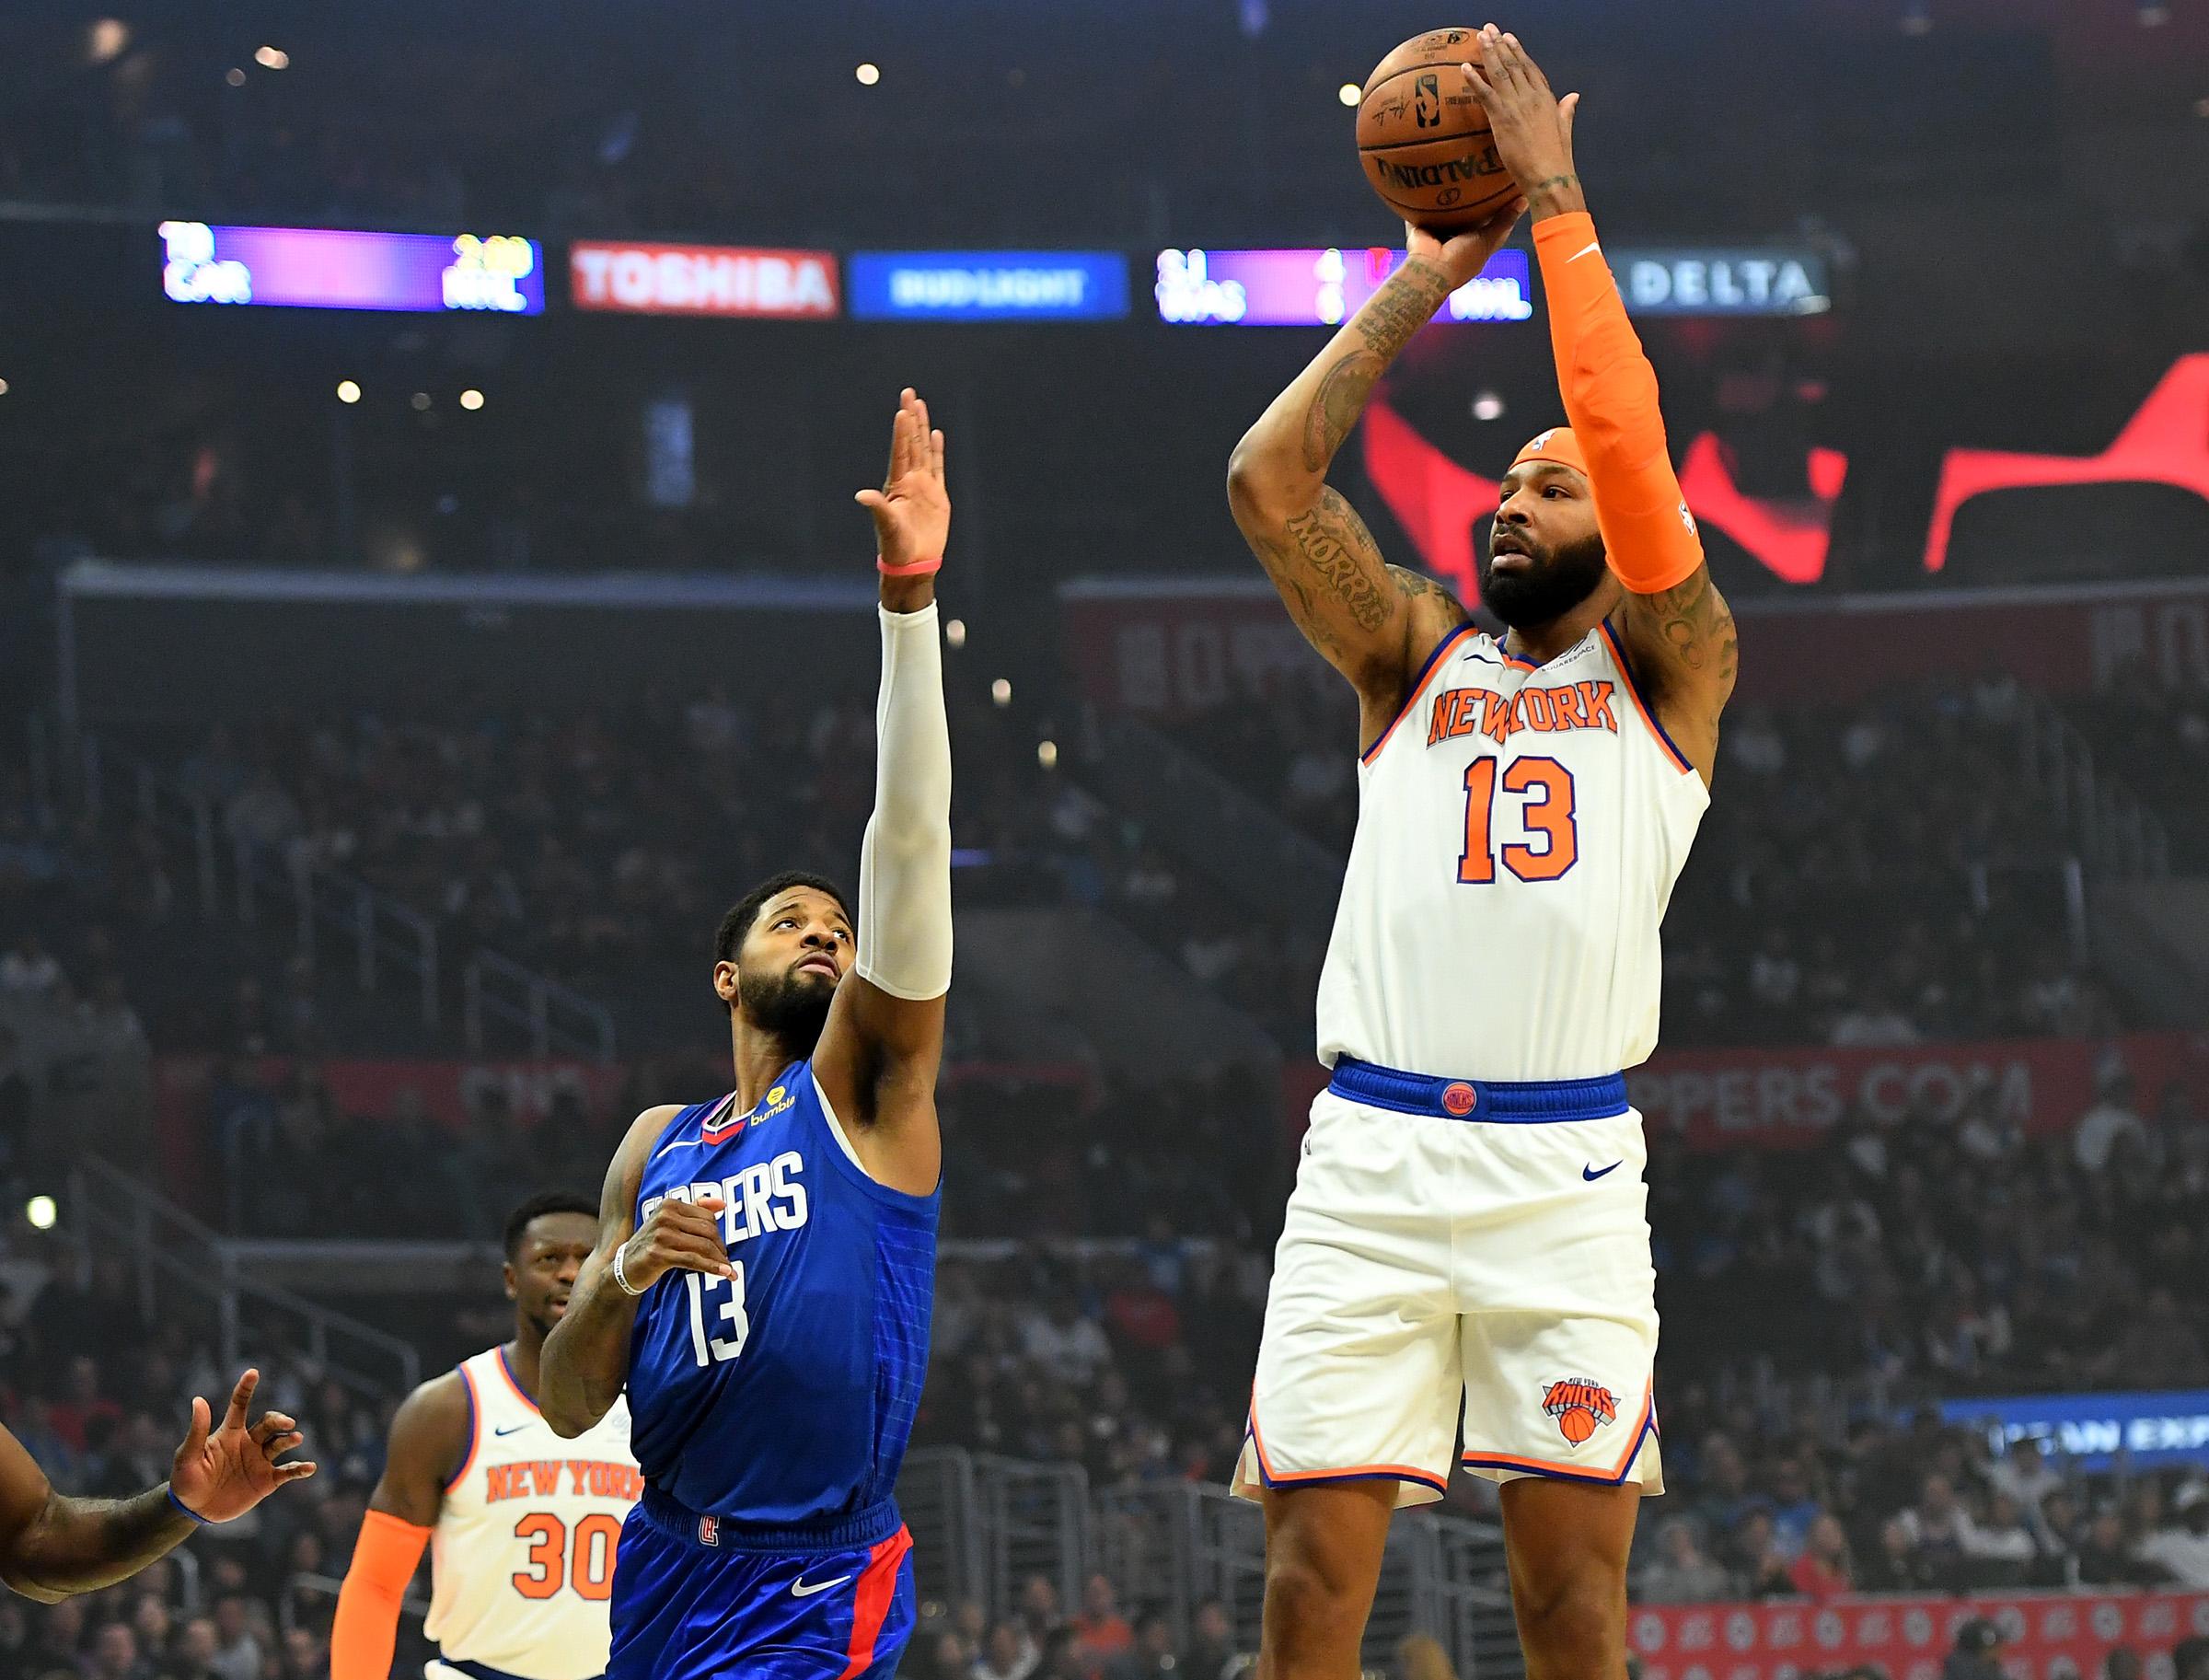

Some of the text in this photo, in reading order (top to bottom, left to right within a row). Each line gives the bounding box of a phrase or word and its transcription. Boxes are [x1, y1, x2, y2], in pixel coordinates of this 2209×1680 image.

[572, 248, 836, 311] TOSHIBA
[1630, 260, 1815, 308] DELTA
[1427, 687, 1509, 750] NEW
[1456, 755, 1579, 885] 13
[750, 1095, 795, 1127] bumble
[685, 1260, 749, 1367] 13
[1543, 1381, 1616, 1423] KNICKS
[486, 1460, 561, 1503] NEW
[512, 1512, 623, 1601] 30
